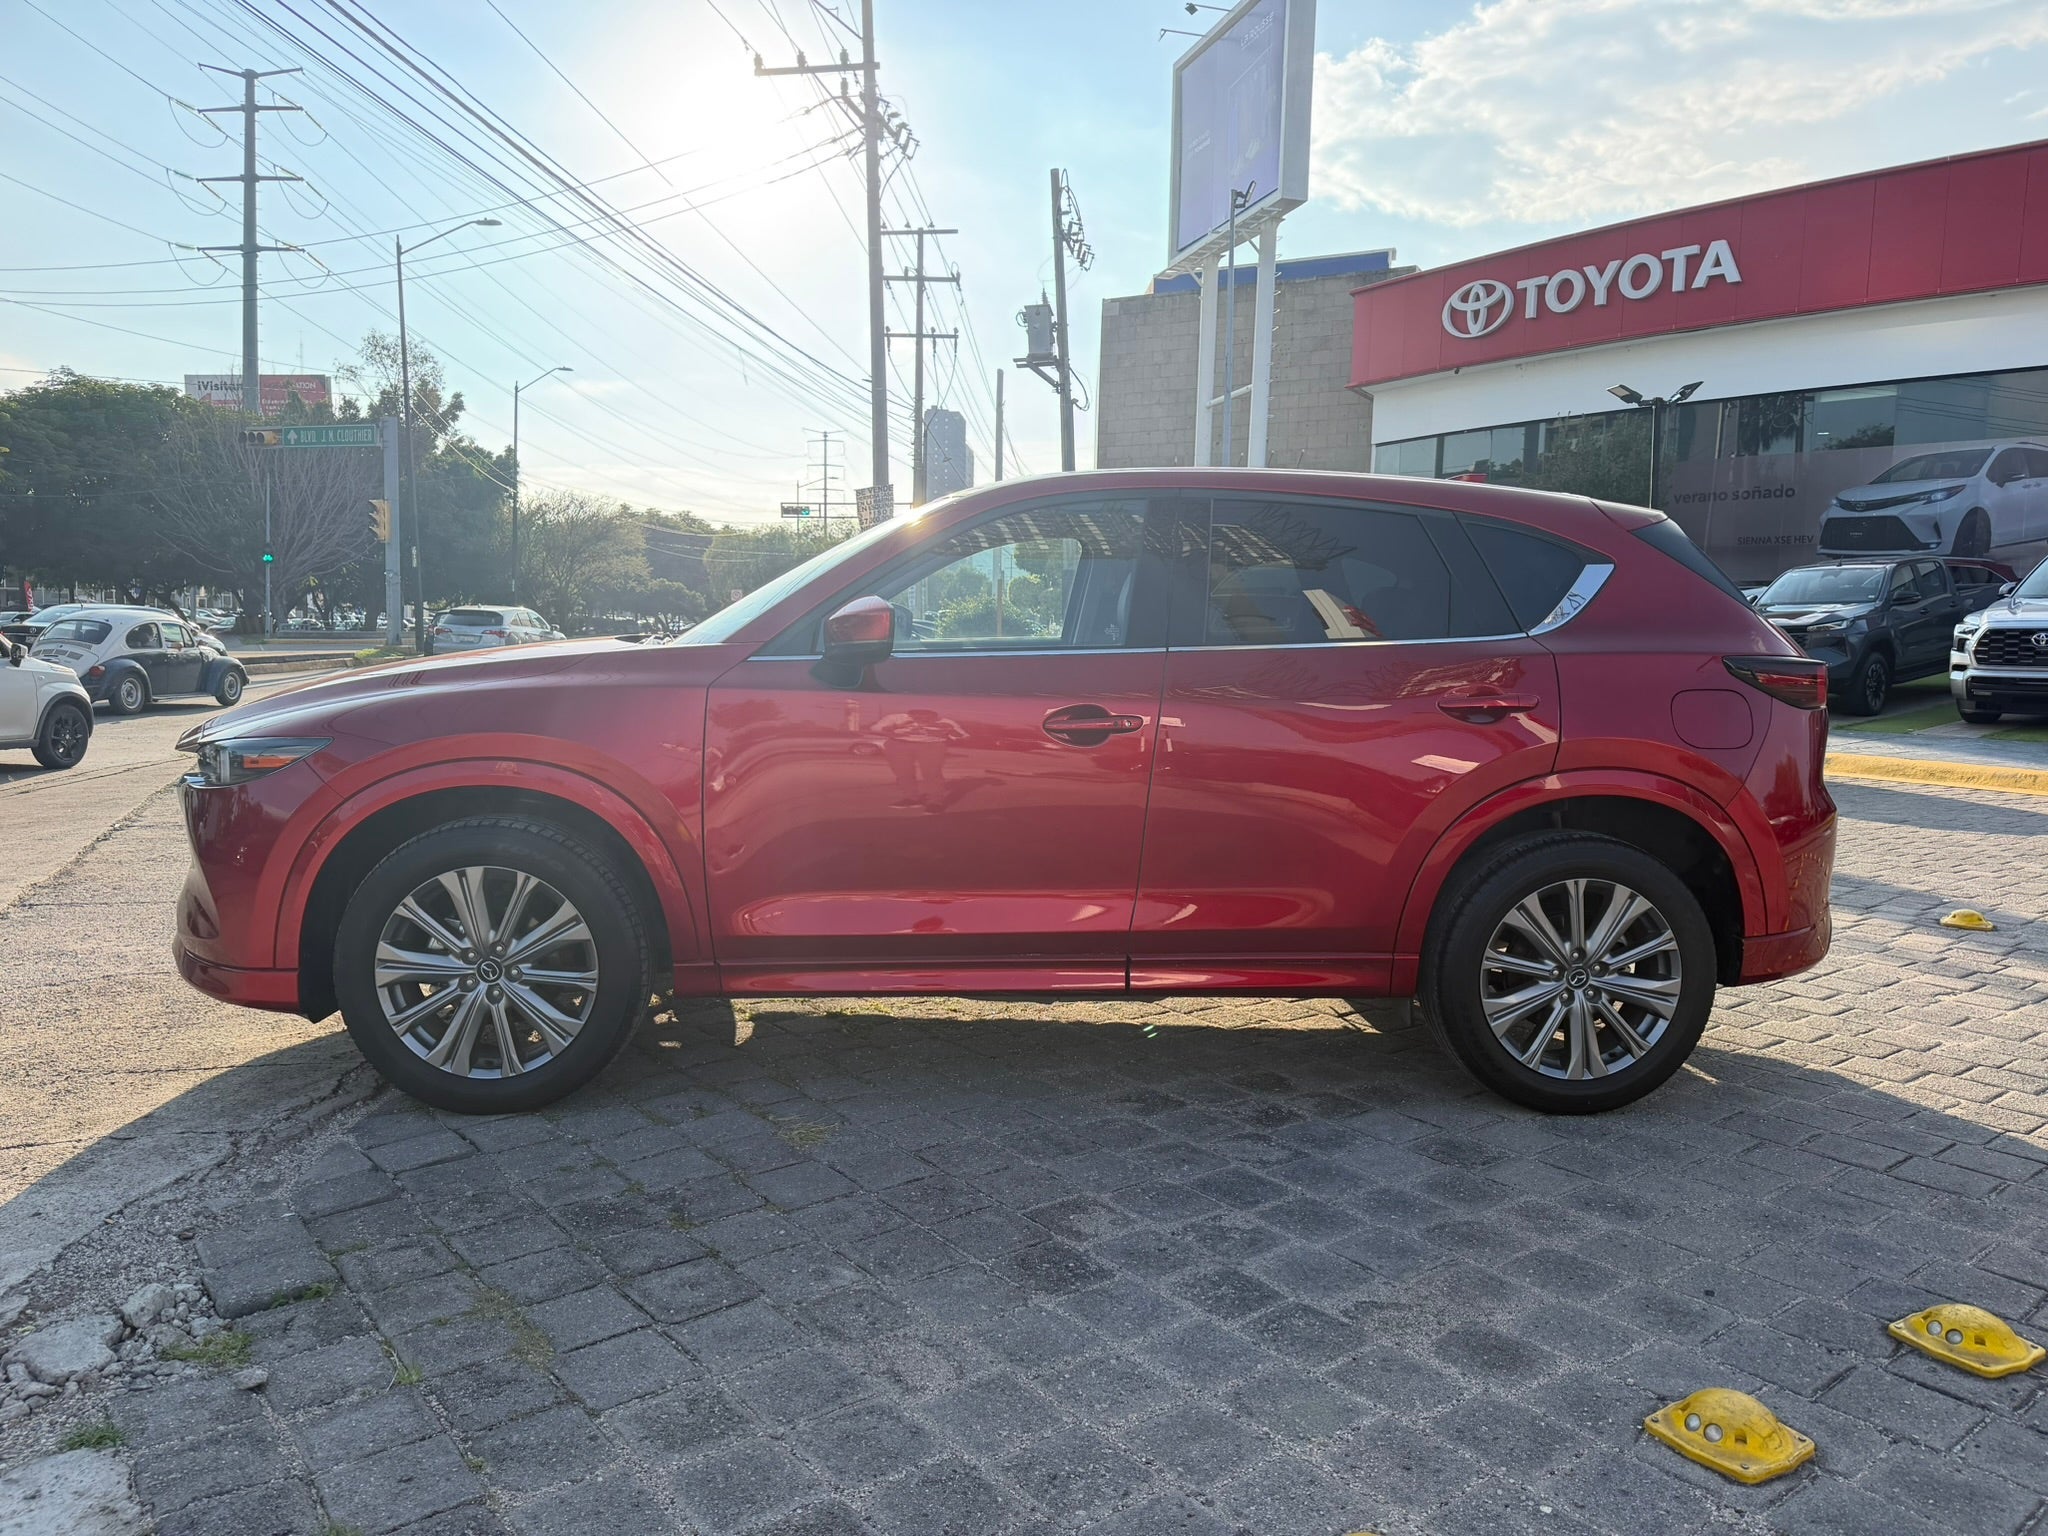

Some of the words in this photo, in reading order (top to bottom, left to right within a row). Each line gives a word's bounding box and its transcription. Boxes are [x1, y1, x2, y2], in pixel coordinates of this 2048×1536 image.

[1516, 239, 1742, 319] TOYOTA
[1674, 489, 1729, 505] verano
[1732, 484, 1796, 501] soñado
[1737, 536, 1772, 546] SIENNA
[1774, 535, 1792, 545] XSE
[1793, 535, 1814, 544] HEV
